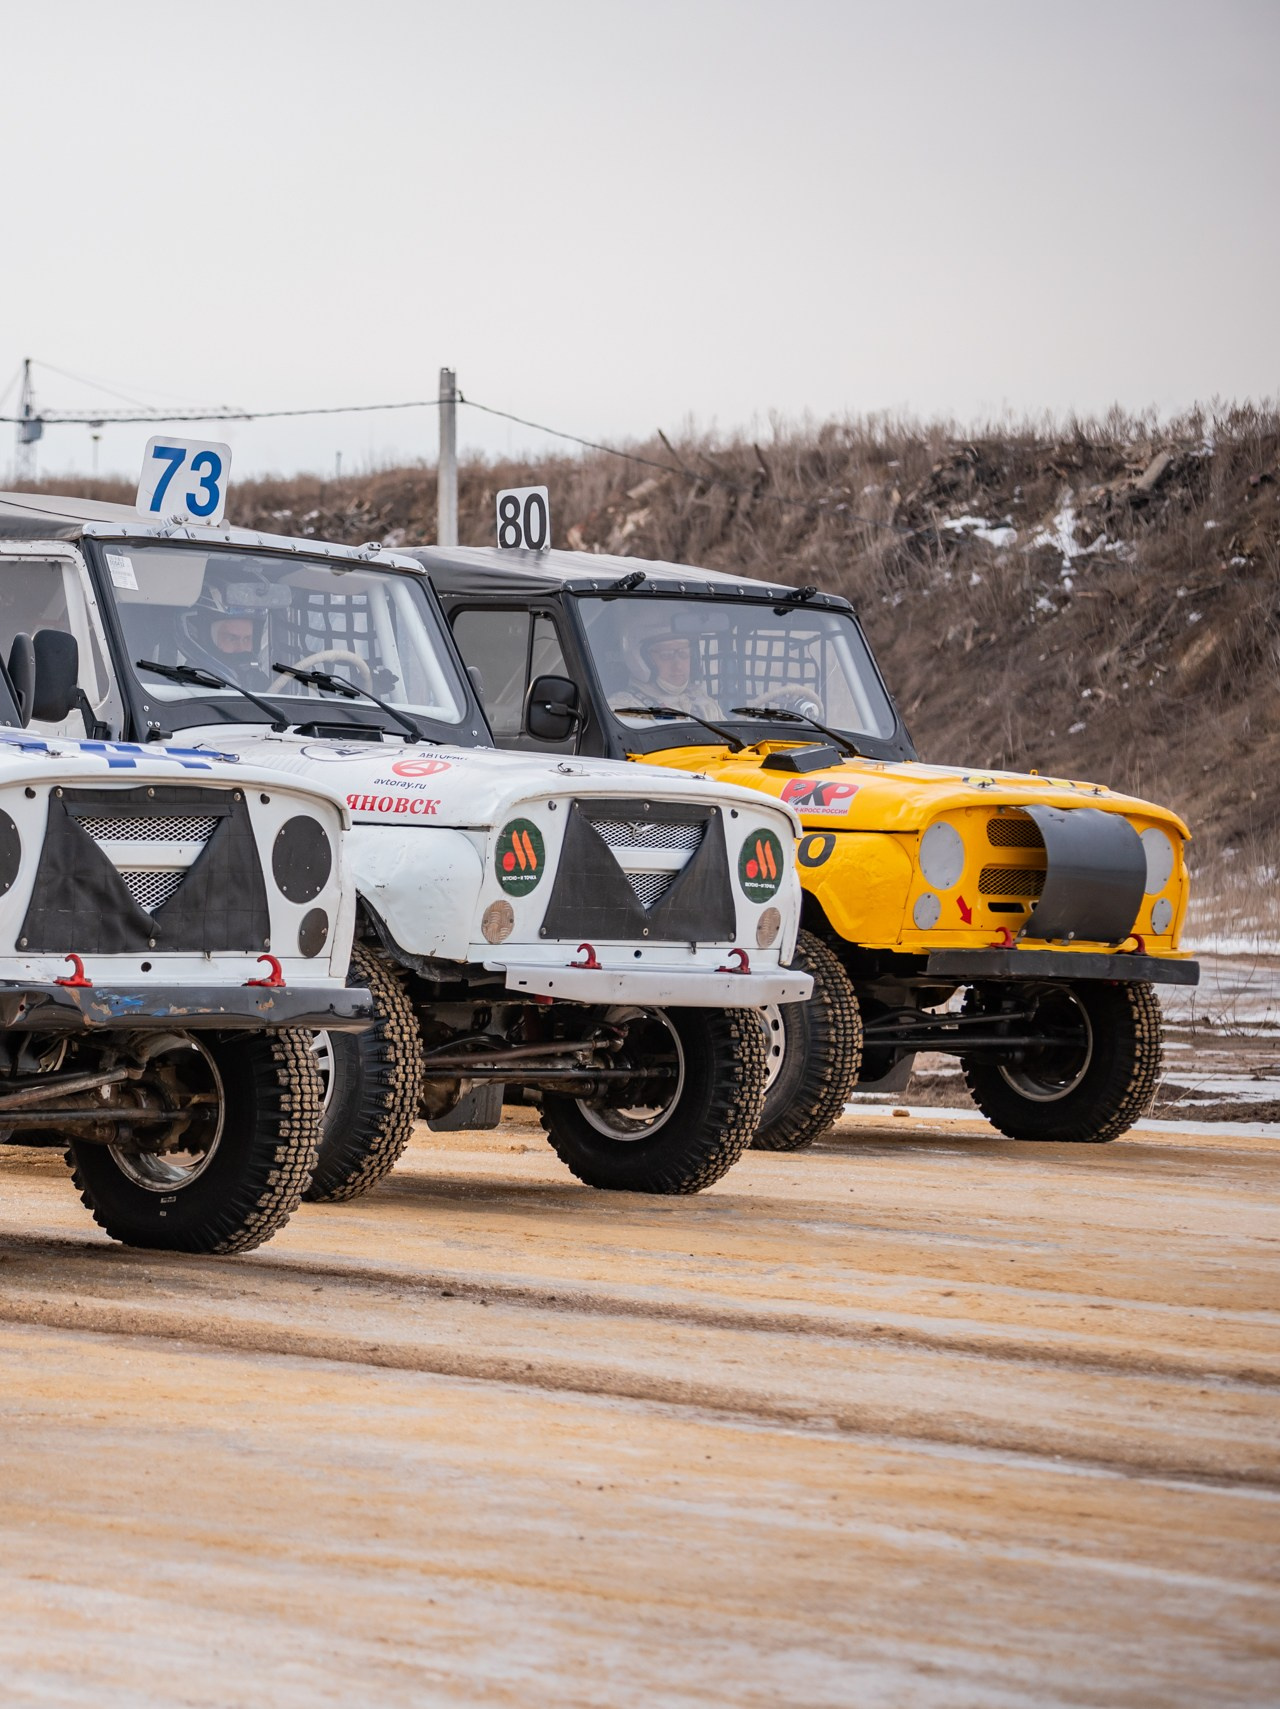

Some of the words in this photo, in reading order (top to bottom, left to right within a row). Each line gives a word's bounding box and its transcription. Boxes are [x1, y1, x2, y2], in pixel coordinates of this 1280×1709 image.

[149, 445, 222, 517] 73
[499, 493, 546, 549] 80
[373, 777, 427, 790] avtoray.ru
[345, 793, 442, 815] ЯНОВСК
